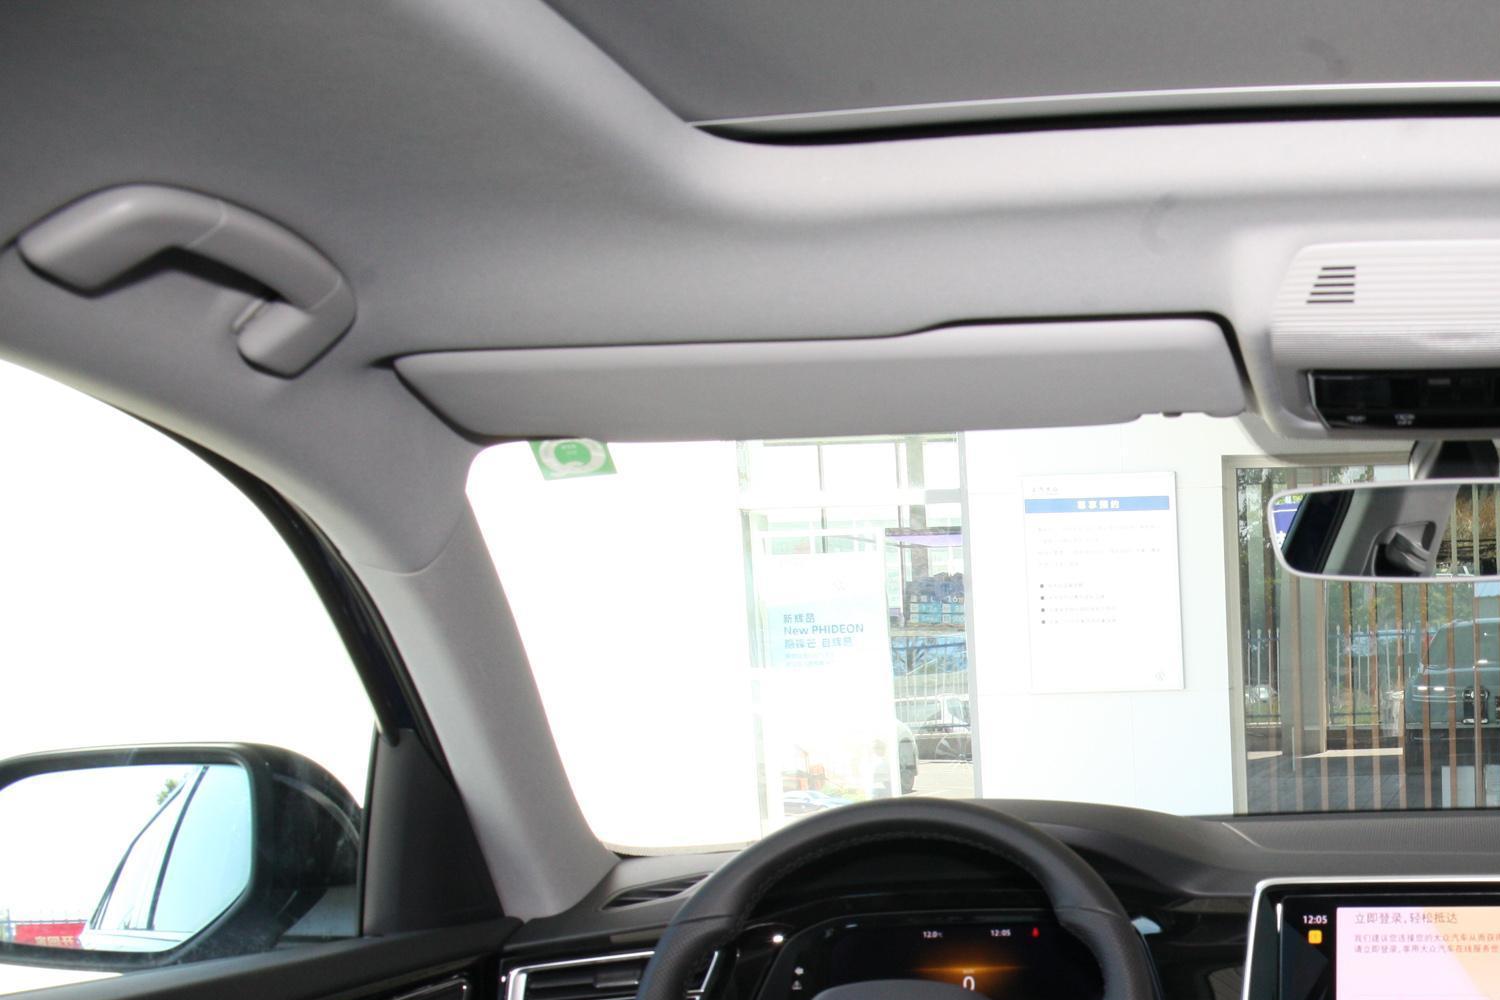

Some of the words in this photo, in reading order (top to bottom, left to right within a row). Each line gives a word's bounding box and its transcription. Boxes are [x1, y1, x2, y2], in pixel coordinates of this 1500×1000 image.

[784, 626, 809, 635] New
[812, 623, 864, 634] PHIDEON
[1303, 915, 1328, 924] 12:05
[990, 929, 1012, 937] 12:05
